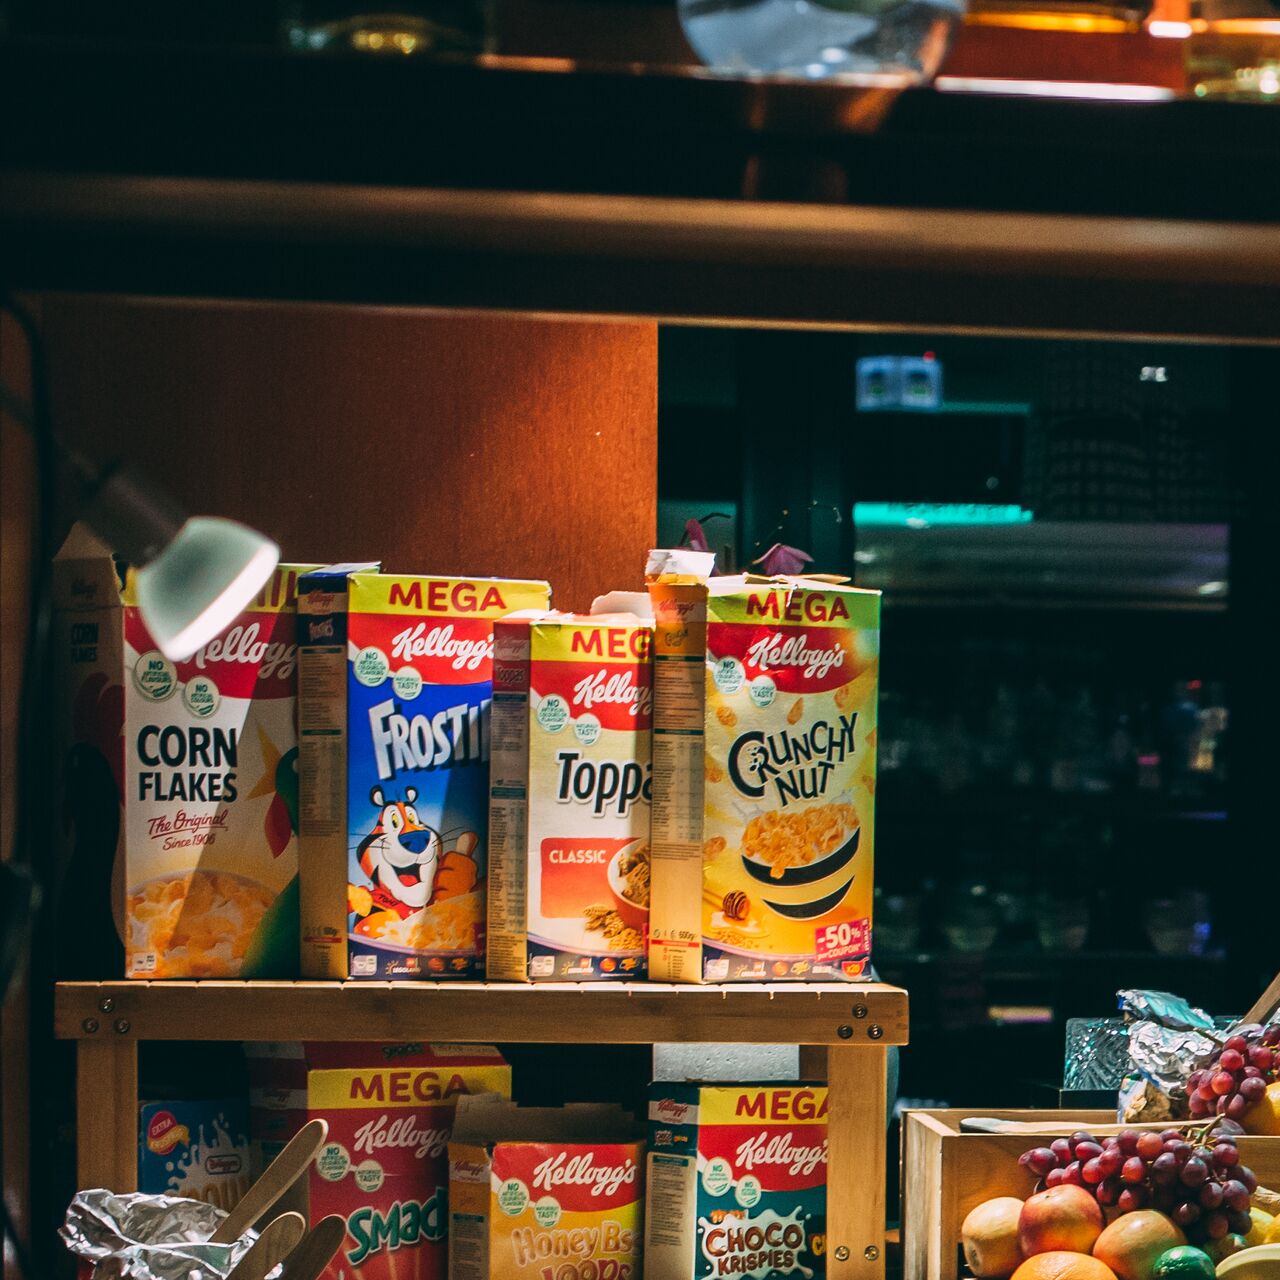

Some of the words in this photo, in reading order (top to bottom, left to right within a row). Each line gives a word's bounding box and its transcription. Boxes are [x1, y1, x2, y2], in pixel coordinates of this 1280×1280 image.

[389, 581, 507, 612] MEGA
[746, 592, 850, 622] MEGA
[149, 661, 164, 670] NO
[365, 652, 378, 660] NO
[723, 661, 735, 669] NO
[748, 632, 846, 679] Kellogg's
[195, 684, 208, 692] NO
[547, 699, 559, 707] NO
[573, 669, 652, 716] Kellog
[137, 725, 237, 767] CORN
[728, 712, 858, 797] CRUNCHY
[138, 772, 238, 802] FLAKES
[775, 761, 834, 806] NUT
[148, 815, 171, 834] The
[174, 809, 228, 833] Original
[163, 835, 191, 850] Since
[192, 833, 216, 845] 1906
[549, 850, 606, 864] CLASSIC
[350, 1071, 471, 1101] MEGA
[326, 1147, 340, 1155] NO
[507, 1183, 519, 1191] NO
[532, 1152, 636, 1196] Kellogg's
[511, 1226, 599, 1267] Honey
[705, 1222, 803, 1257] CHOCO
[717, 1250, 794, 1276] KRISPIES
